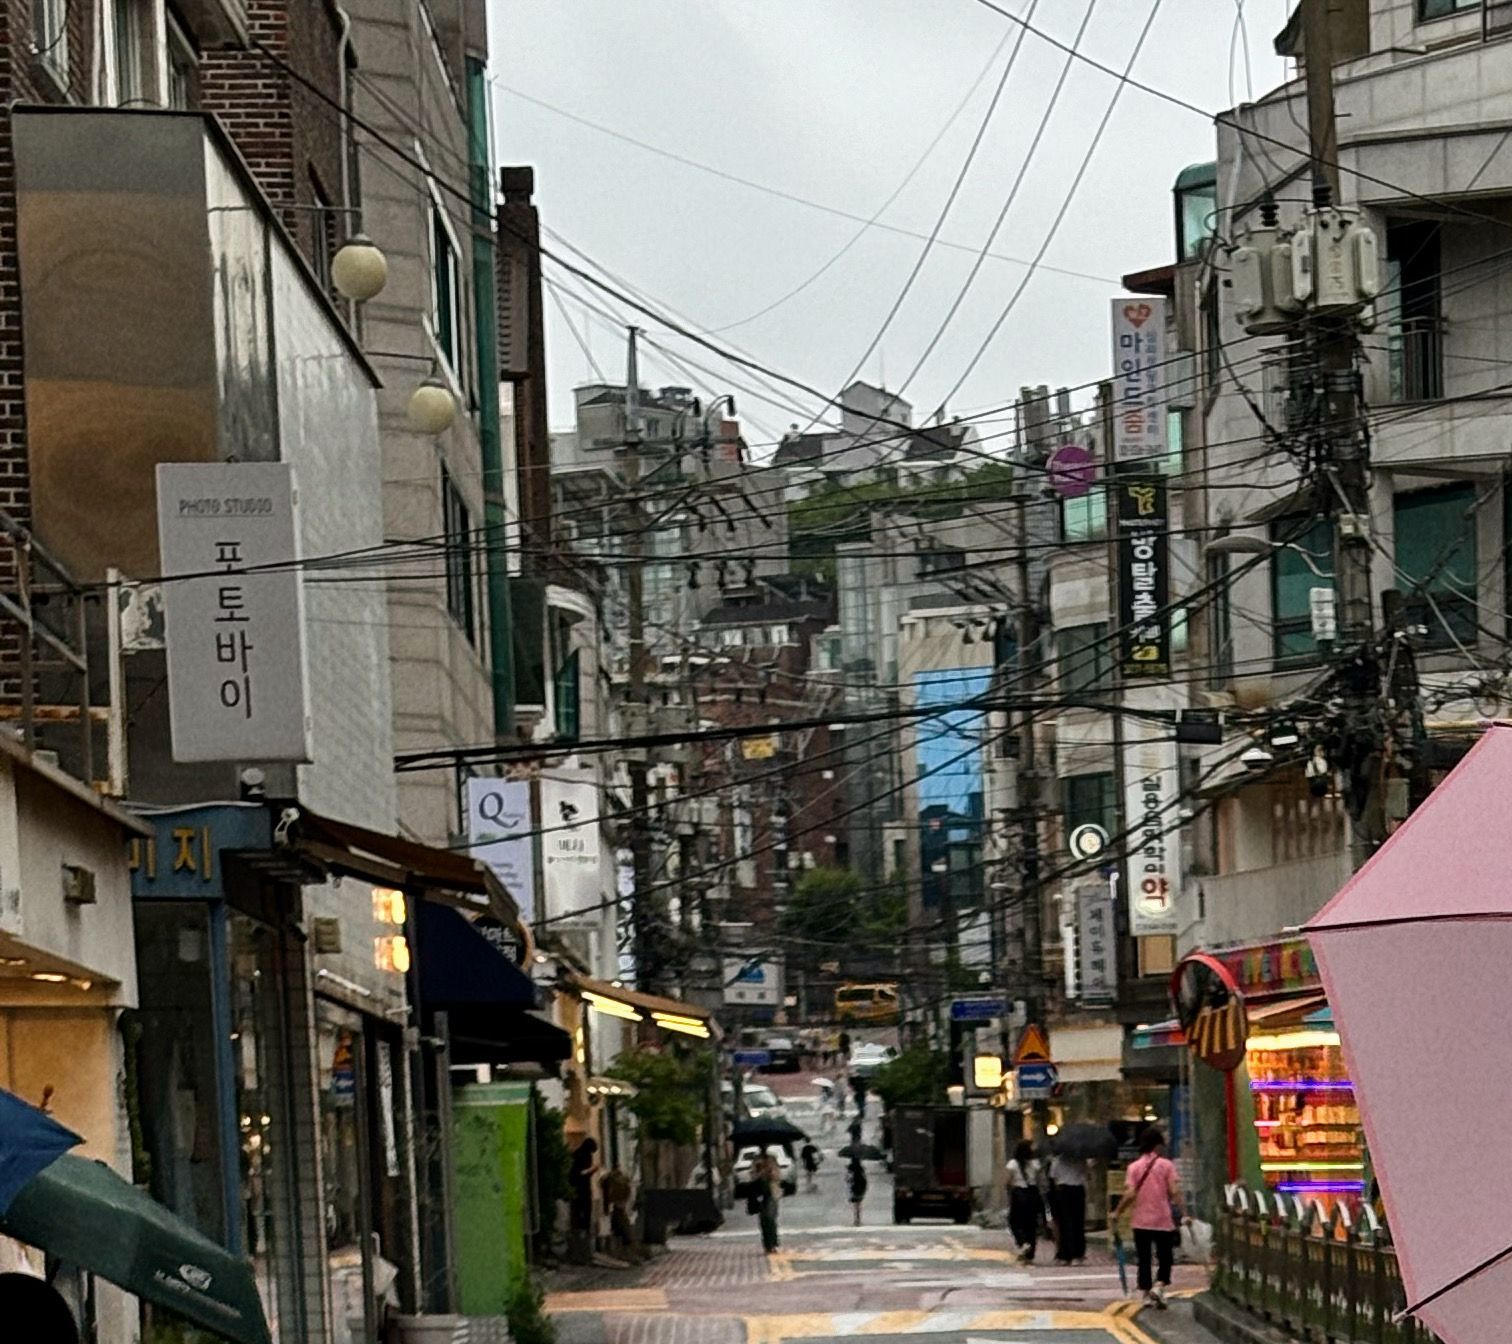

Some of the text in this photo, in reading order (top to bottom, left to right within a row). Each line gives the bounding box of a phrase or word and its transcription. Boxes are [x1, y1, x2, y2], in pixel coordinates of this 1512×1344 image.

[179, 497, 273, 514] PHOTO STUDIO
[214, 541, 254, 719] 포토바이
